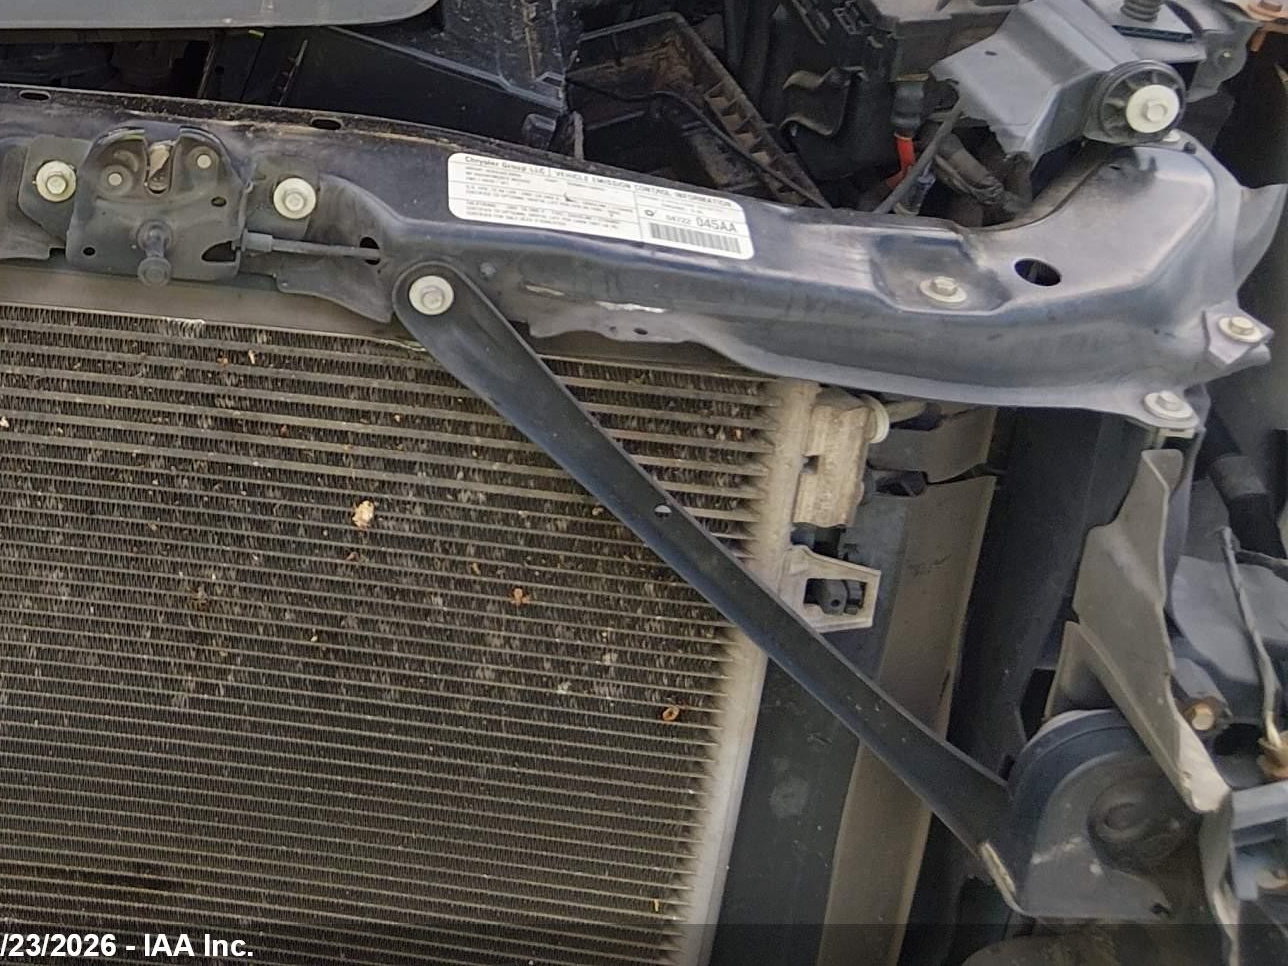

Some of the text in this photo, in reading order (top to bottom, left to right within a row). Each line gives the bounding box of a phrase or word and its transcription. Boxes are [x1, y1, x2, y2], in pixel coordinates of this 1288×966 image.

[465, 155, 500, 167] Chrysler
[502, 161, 527, 172] Group
[555, 170, 589, 183] VEHICLE
